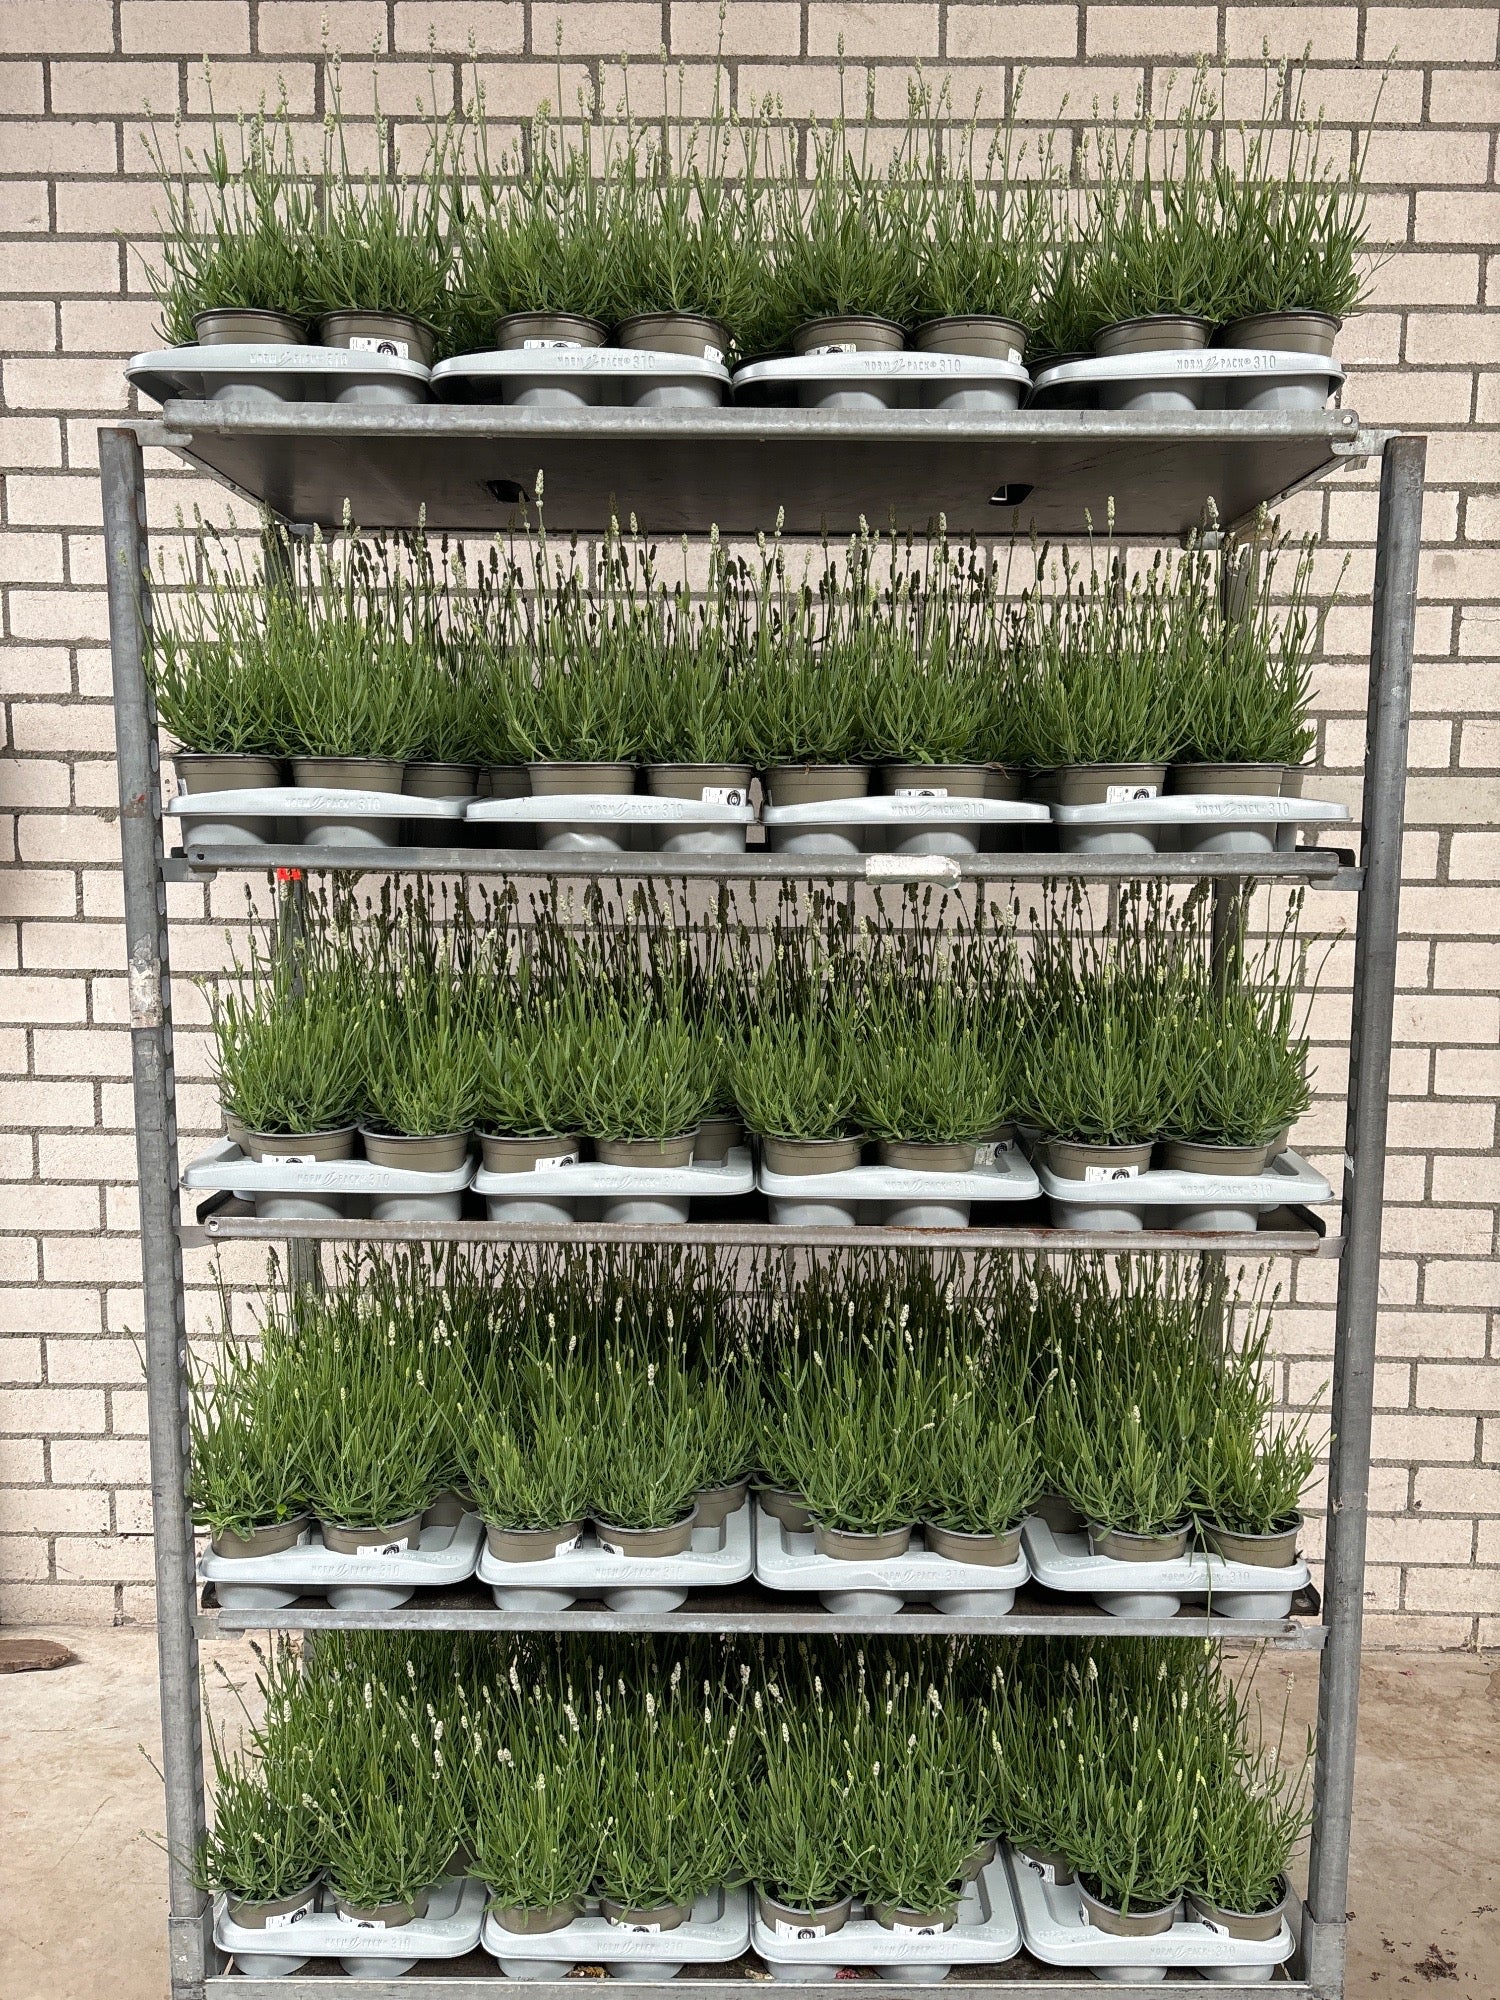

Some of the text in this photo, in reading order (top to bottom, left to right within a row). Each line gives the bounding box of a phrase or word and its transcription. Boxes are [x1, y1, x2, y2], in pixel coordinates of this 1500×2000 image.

[633, 355, 655, 369] 310
[940, 359, 961, 372] 310
[1254, 355, 1276, 369] 310
[663, 803, 684, 817] 310
[964, 803, 985, 817] 310
[1269, 802, 1290, 817] 310
